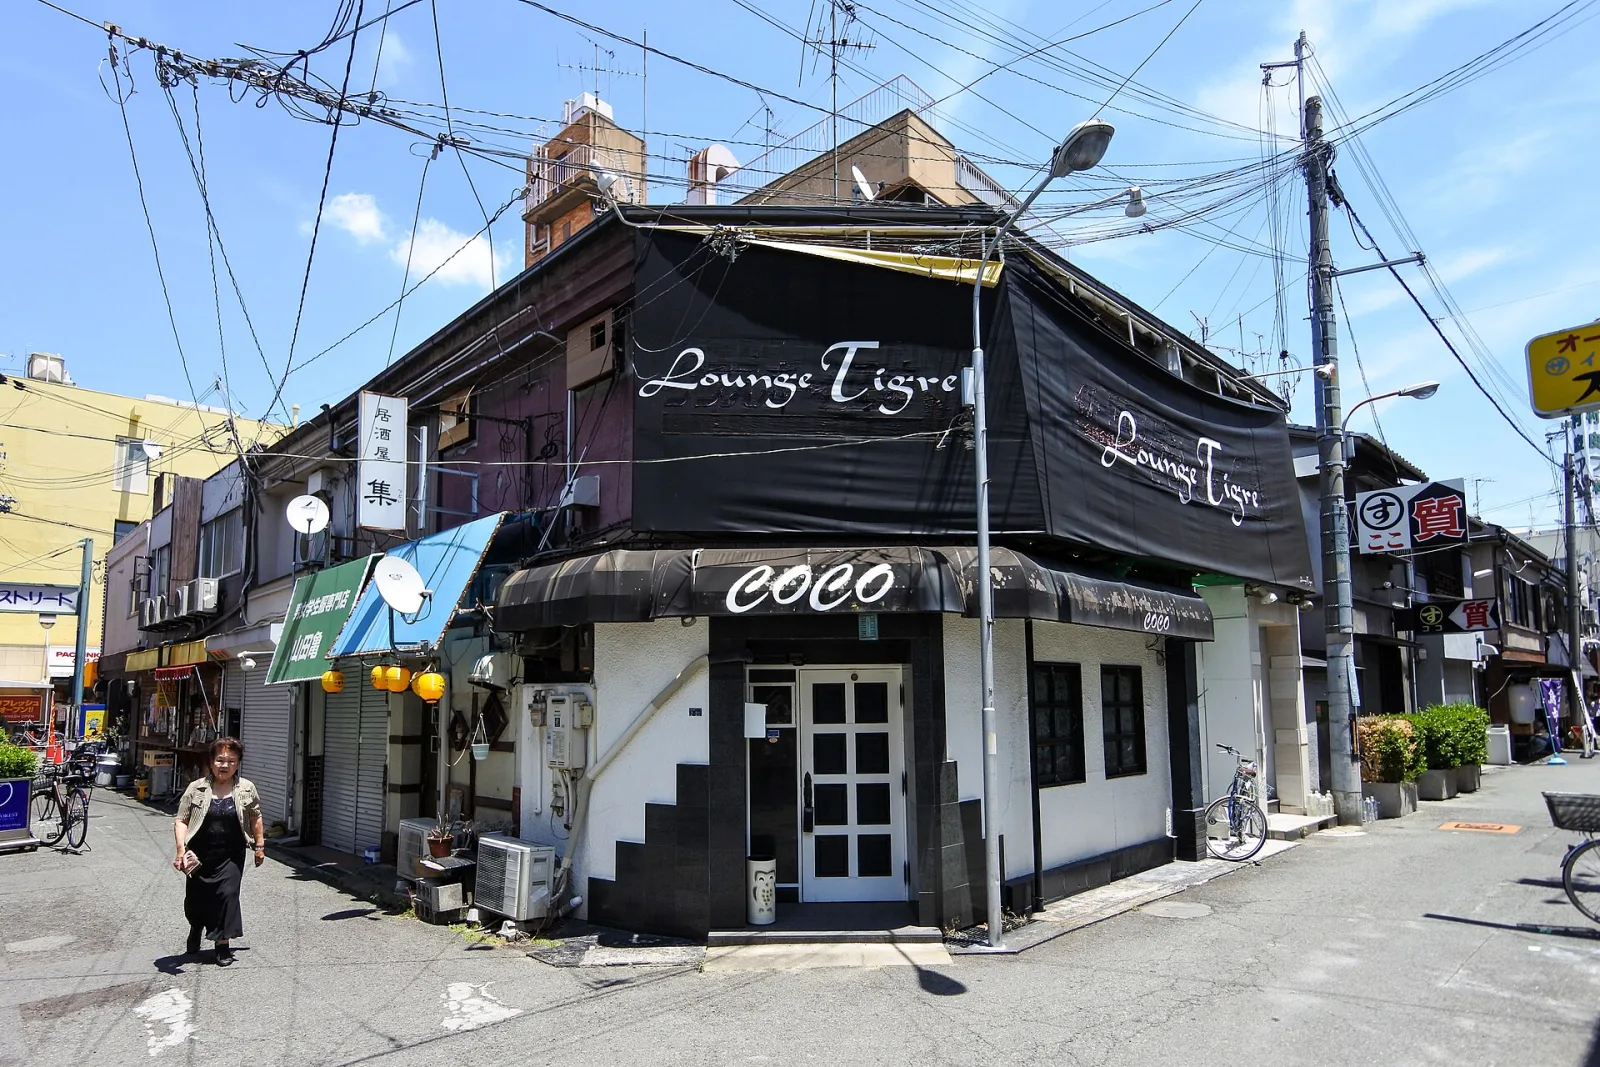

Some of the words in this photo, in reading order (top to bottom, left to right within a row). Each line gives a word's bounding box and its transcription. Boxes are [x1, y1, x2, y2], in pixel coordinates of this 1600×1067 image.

[638, 348, 812, 409] Lounge
[821, 341, 958, 415] Tigre
[374, 408, 392, 460] 居酒屋
[1101, 411, 1197, 504] Lounge
[1197, 437, 1259, 526] Tigre
[364, 479, 398, 507] 集
[1412, 494, 1465, 542] 質
[1368, 532, 1404, 550] ここ
[0, 590, 73, 606] ストリート
[1462, 601, 1489, 629] 質
